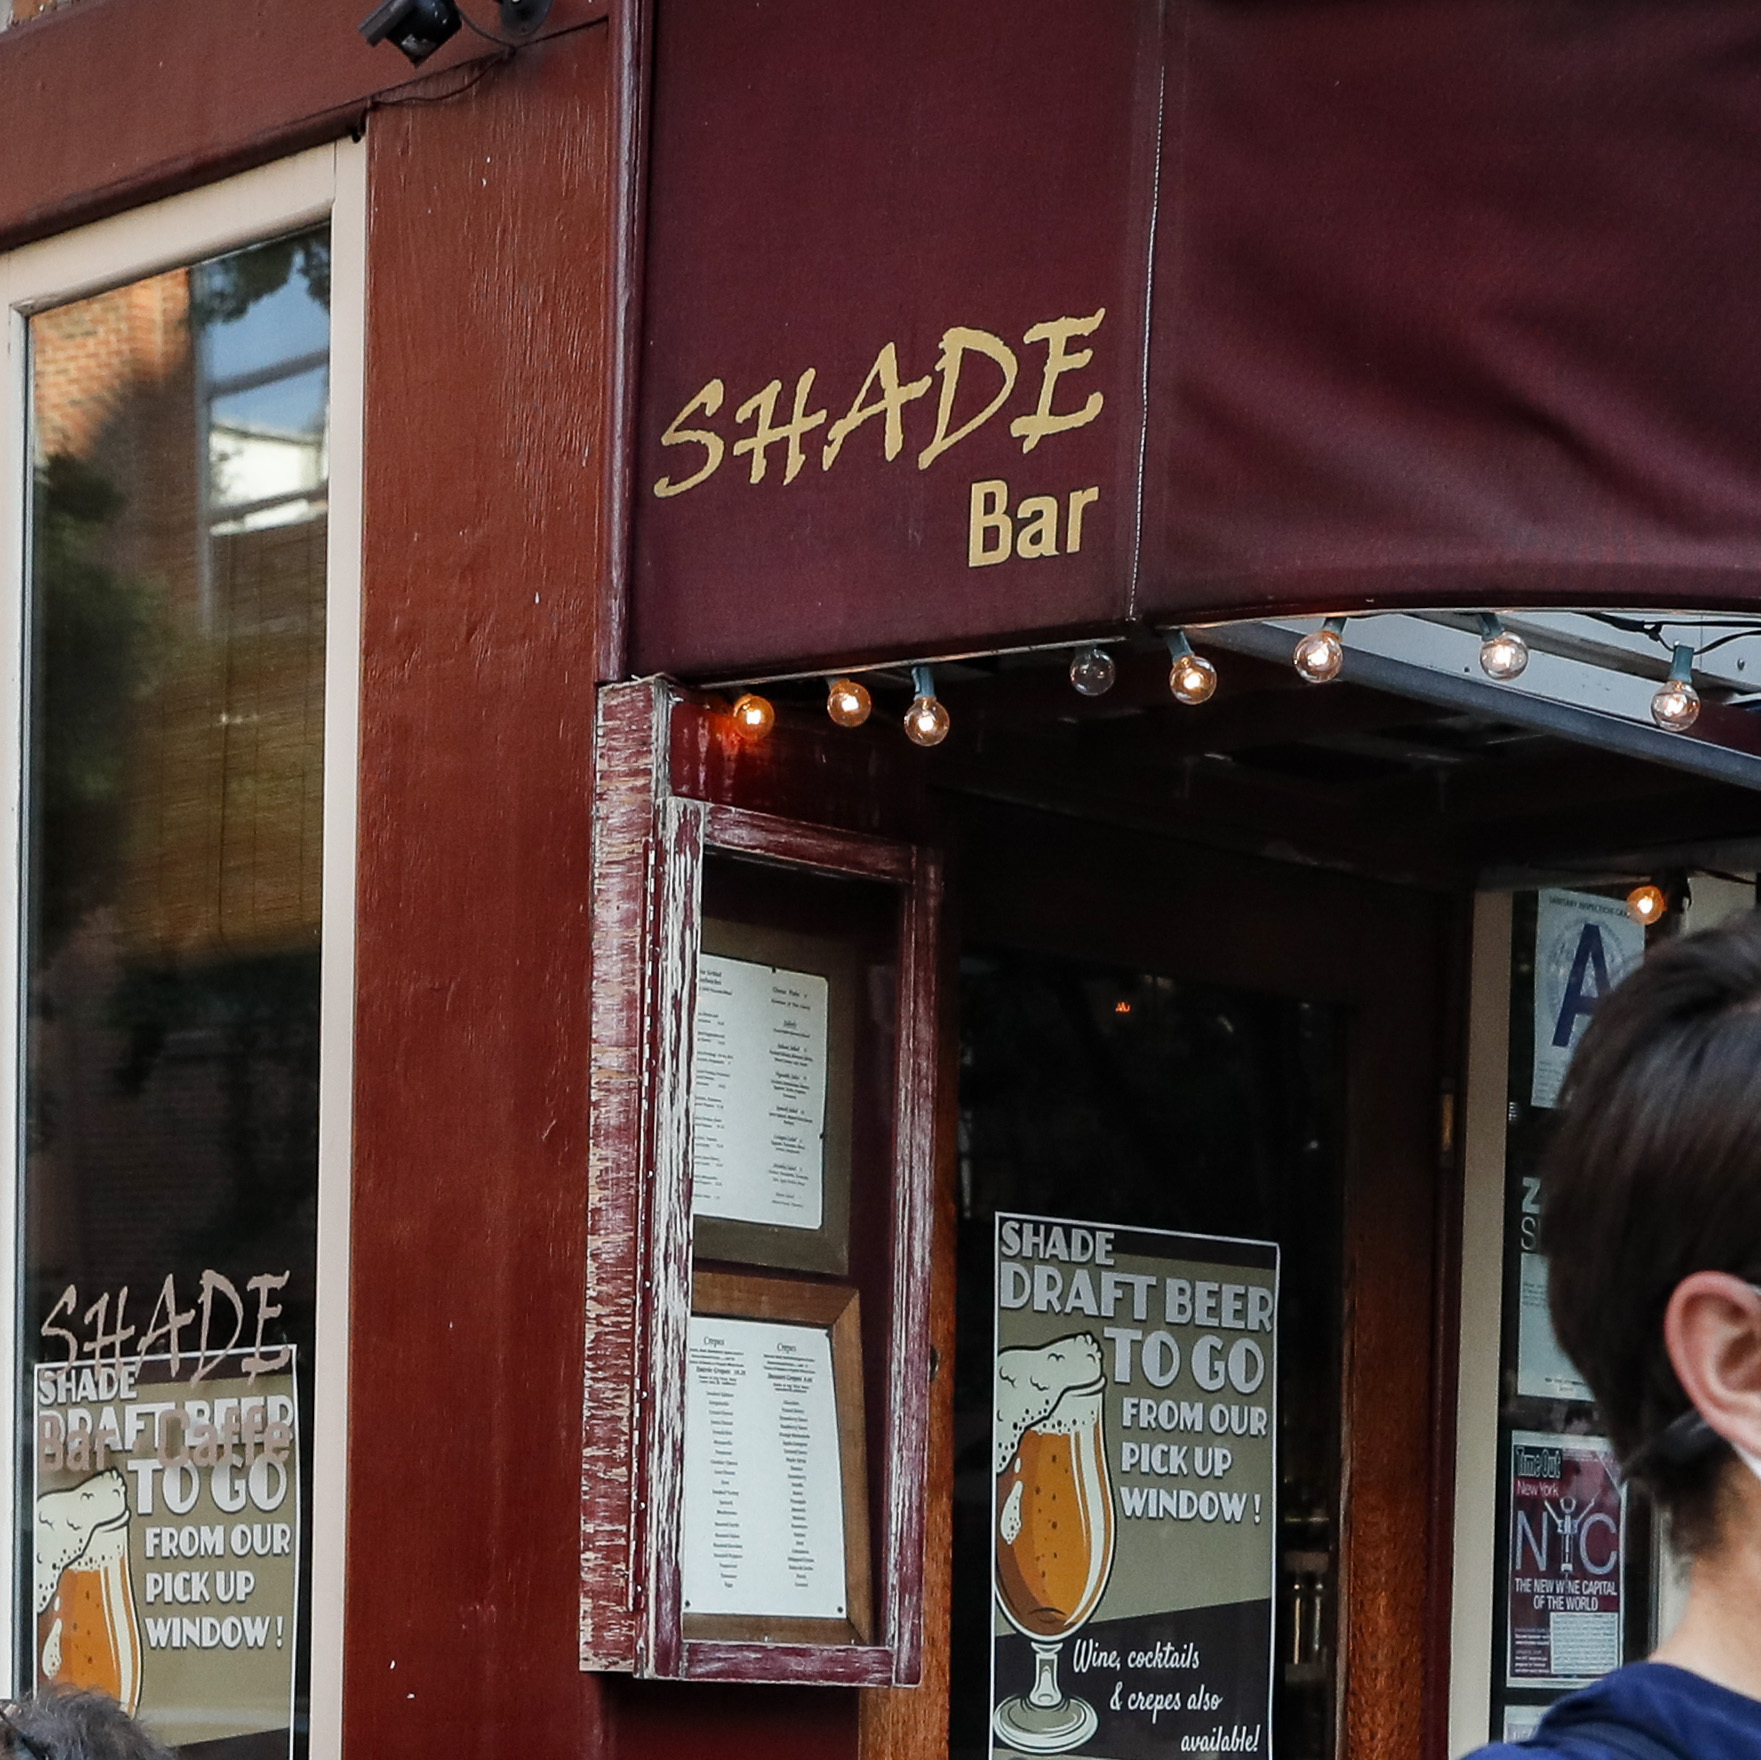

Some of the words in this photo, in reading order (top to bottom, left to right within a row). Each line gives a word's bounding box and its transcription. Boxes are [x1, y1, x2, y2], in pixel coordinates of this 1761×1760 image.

[653, 307, 1106, 498] SHADE
[968, 478, 1100, 568] Bar
[1551, 922, 1611, 1048] A
[1000, 1221, 1115, 1266] SHADE
[1000, 1262, 1157, 1321] DRAFT
[1164, 1278, 1274, 1333] BEER
[41, 1269, 291, 1390] SHADE
[1103, 1326, 1181, 1388] TO
[1191, 1334, 1265, 1394] GO
[37, 1365, 138, 1406] SHADE
[1122, 1397, 1204, 1433] FROM
[1209, 1403, 1268, 1437] OUR
[1121, 1441, 1188, 1477] PICK
[1193, 1446, 1233, 1479] UP
[127, 1459, 200, 1515] TO
[210, 1454, 288, 1514] GO
[144, 1524, 225, 1558] FROM
[230, 1523, 292, 1557] OUR
[144, 1571, 211, 1605] PICK
[215, 1570, 256, 1602] UP
[1073, 1638, 1122, 1673] Wine,
[1127, 1641, 1200, 1670] cocktails
[1109, 1681, 1124, 1711] &
[1127, 1691, 1181, 1724] crepes
[1186, 1684, 1224, 1711] also
[1180, 1724, 1261, 1753] available!
